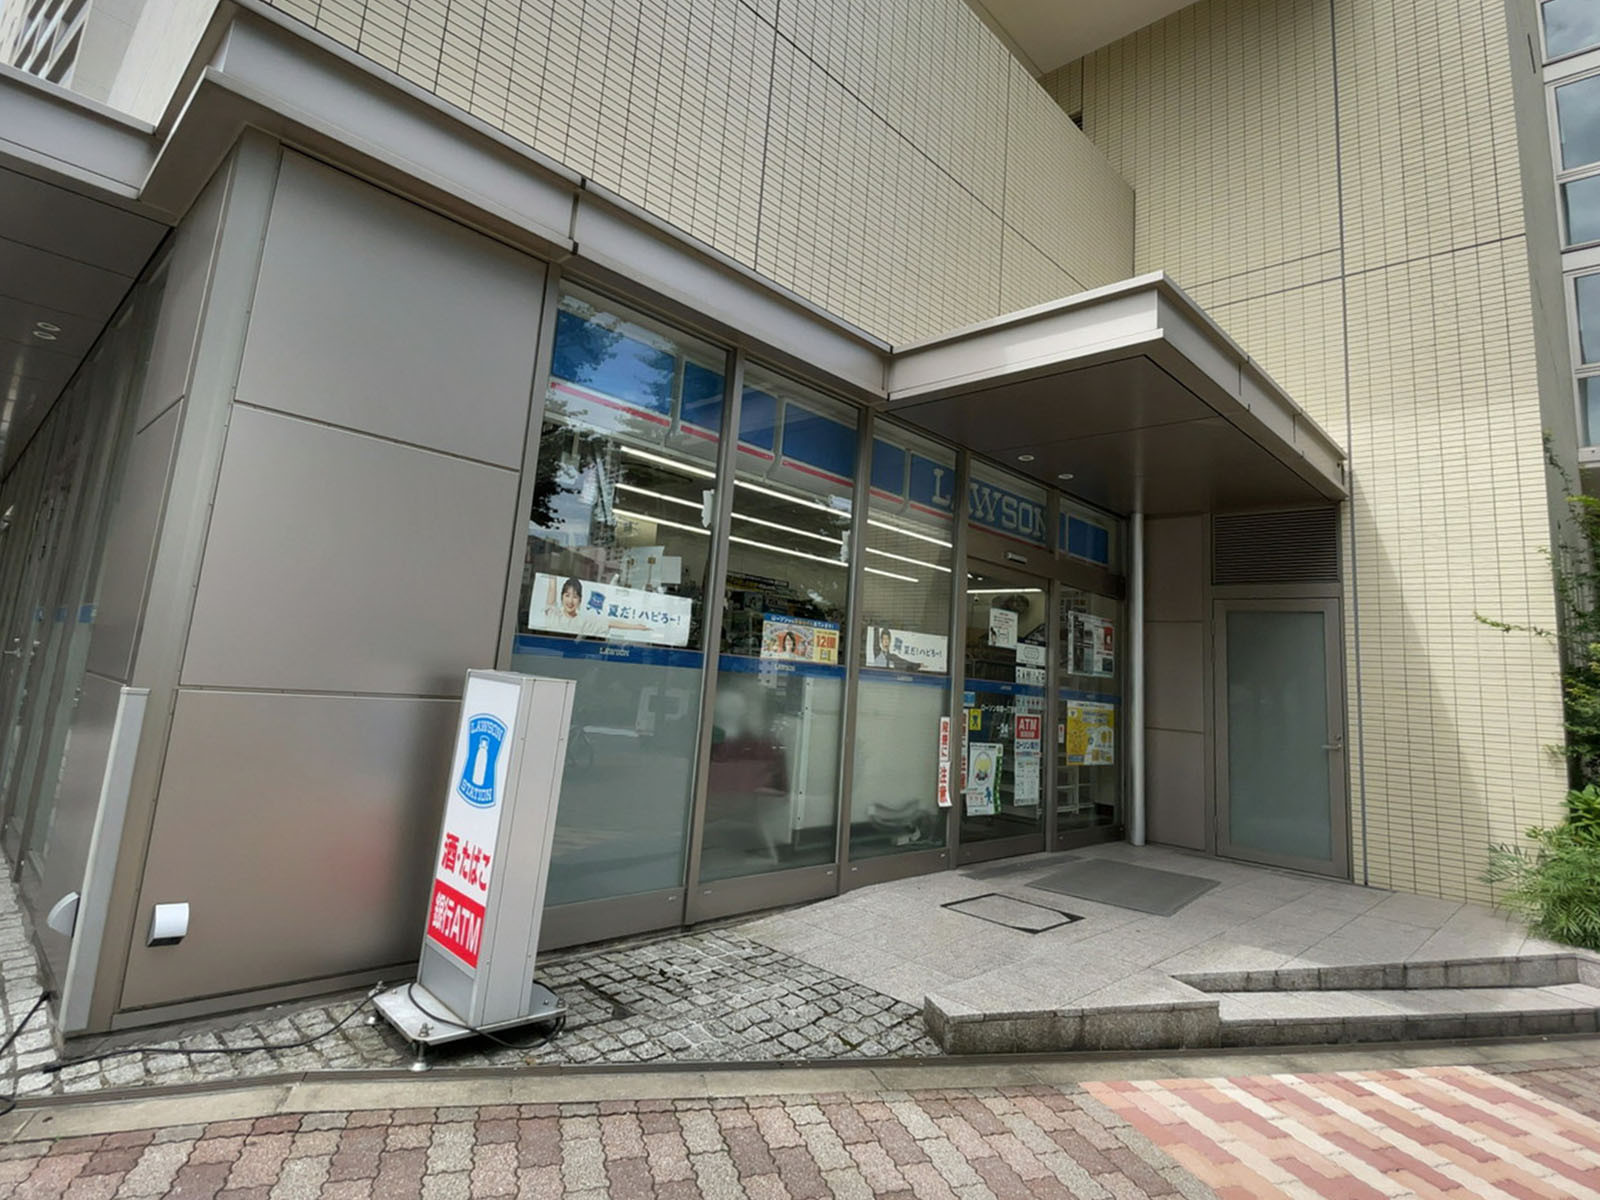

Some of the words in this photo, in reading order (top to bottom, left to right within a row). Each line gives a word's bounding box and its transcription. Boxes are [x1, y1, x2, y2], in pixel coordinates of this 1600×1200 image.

[931, 467, 1047, 541] LWSON
[470, 717, 504, 743] LAWSON
[1018, 718, 1038, 730] ATM
[460, 780, 494, 802] STATION
[442, 832, 490, 889] 酒・たばこ
[433, 891, 482, 956] 銀行ATM
